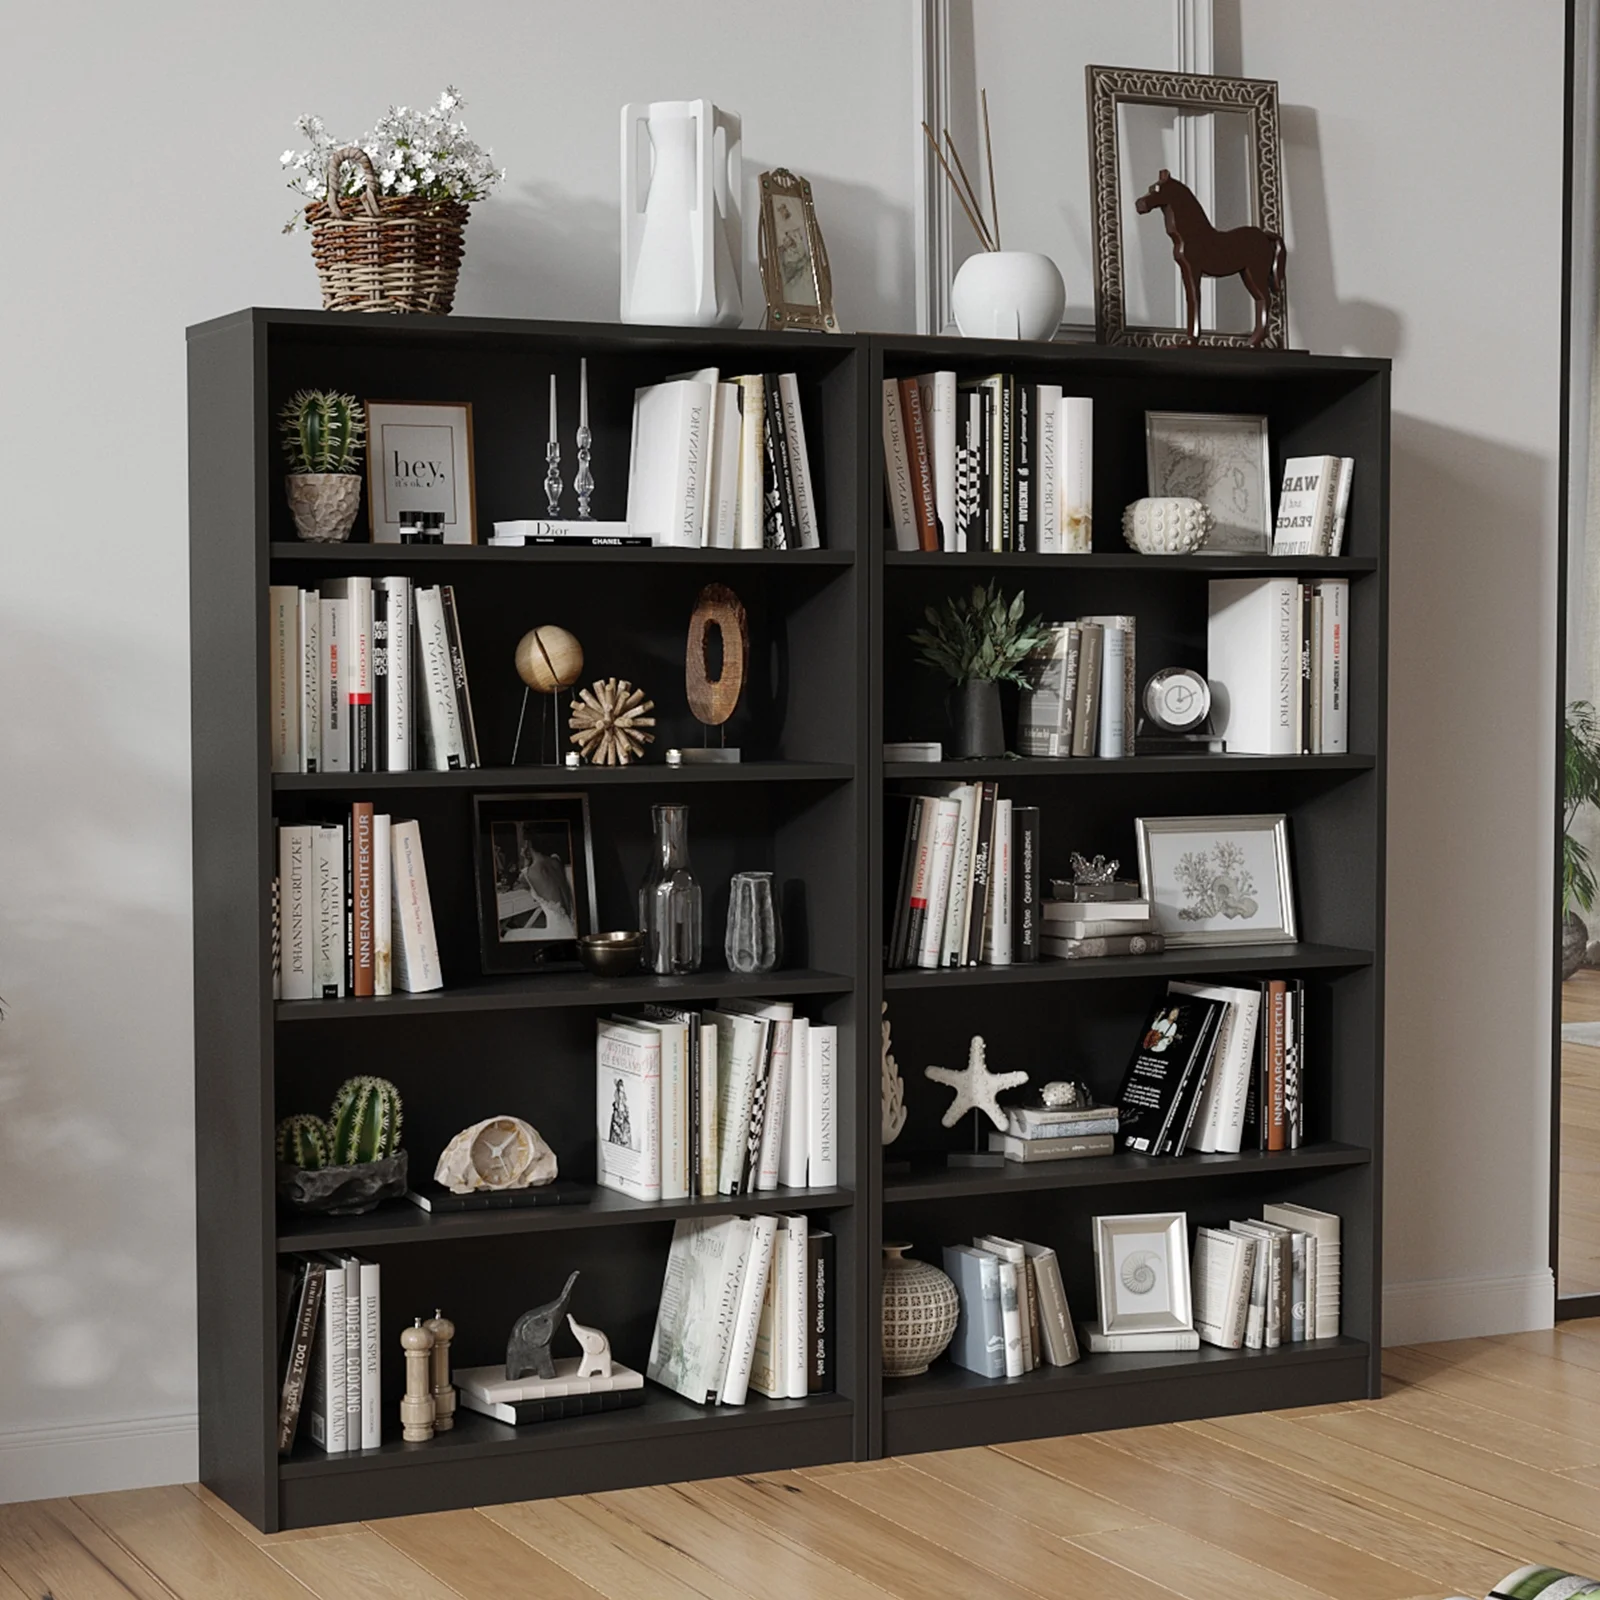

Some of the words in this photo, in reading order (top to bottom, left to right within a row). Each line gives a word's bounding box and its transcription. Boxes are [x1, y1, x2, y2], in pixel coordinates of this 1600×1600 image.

[393, 450, 446, 488] hey,
[536, 521, 569, 535] Dior
[1280, 588, 1290, 657] GRÜTZKE
[1066, 649, 1078, 677] Sherlock
[1280, 659, 1290, 728] JOHANNES
[291, 836, 303, 901] GRÜTZKE
[359, 814, 370, 968] INNENARCHITEKTUR
[291, 903, 304, 974] JOHANNES
[1274, 992, 1283, 1126] INNENARCHITEKTUR
[1231, 1062, 1247, 1128] JOHANNES
[821, 1099, 831, 1162] JOHANNES
[331, 1283, 345, 1347] VEGETARIAN
[346, 1296, 360, 1350] MODERN
[293, 1343, 307, 1374] DOLI
[332, 1353, 345, 1388] INDIAN
[347, 1357, 360, 1413] COOKING
[285, 1380, 301, 1412] AMET
[332, 1395, 345, 1442] COOKING
